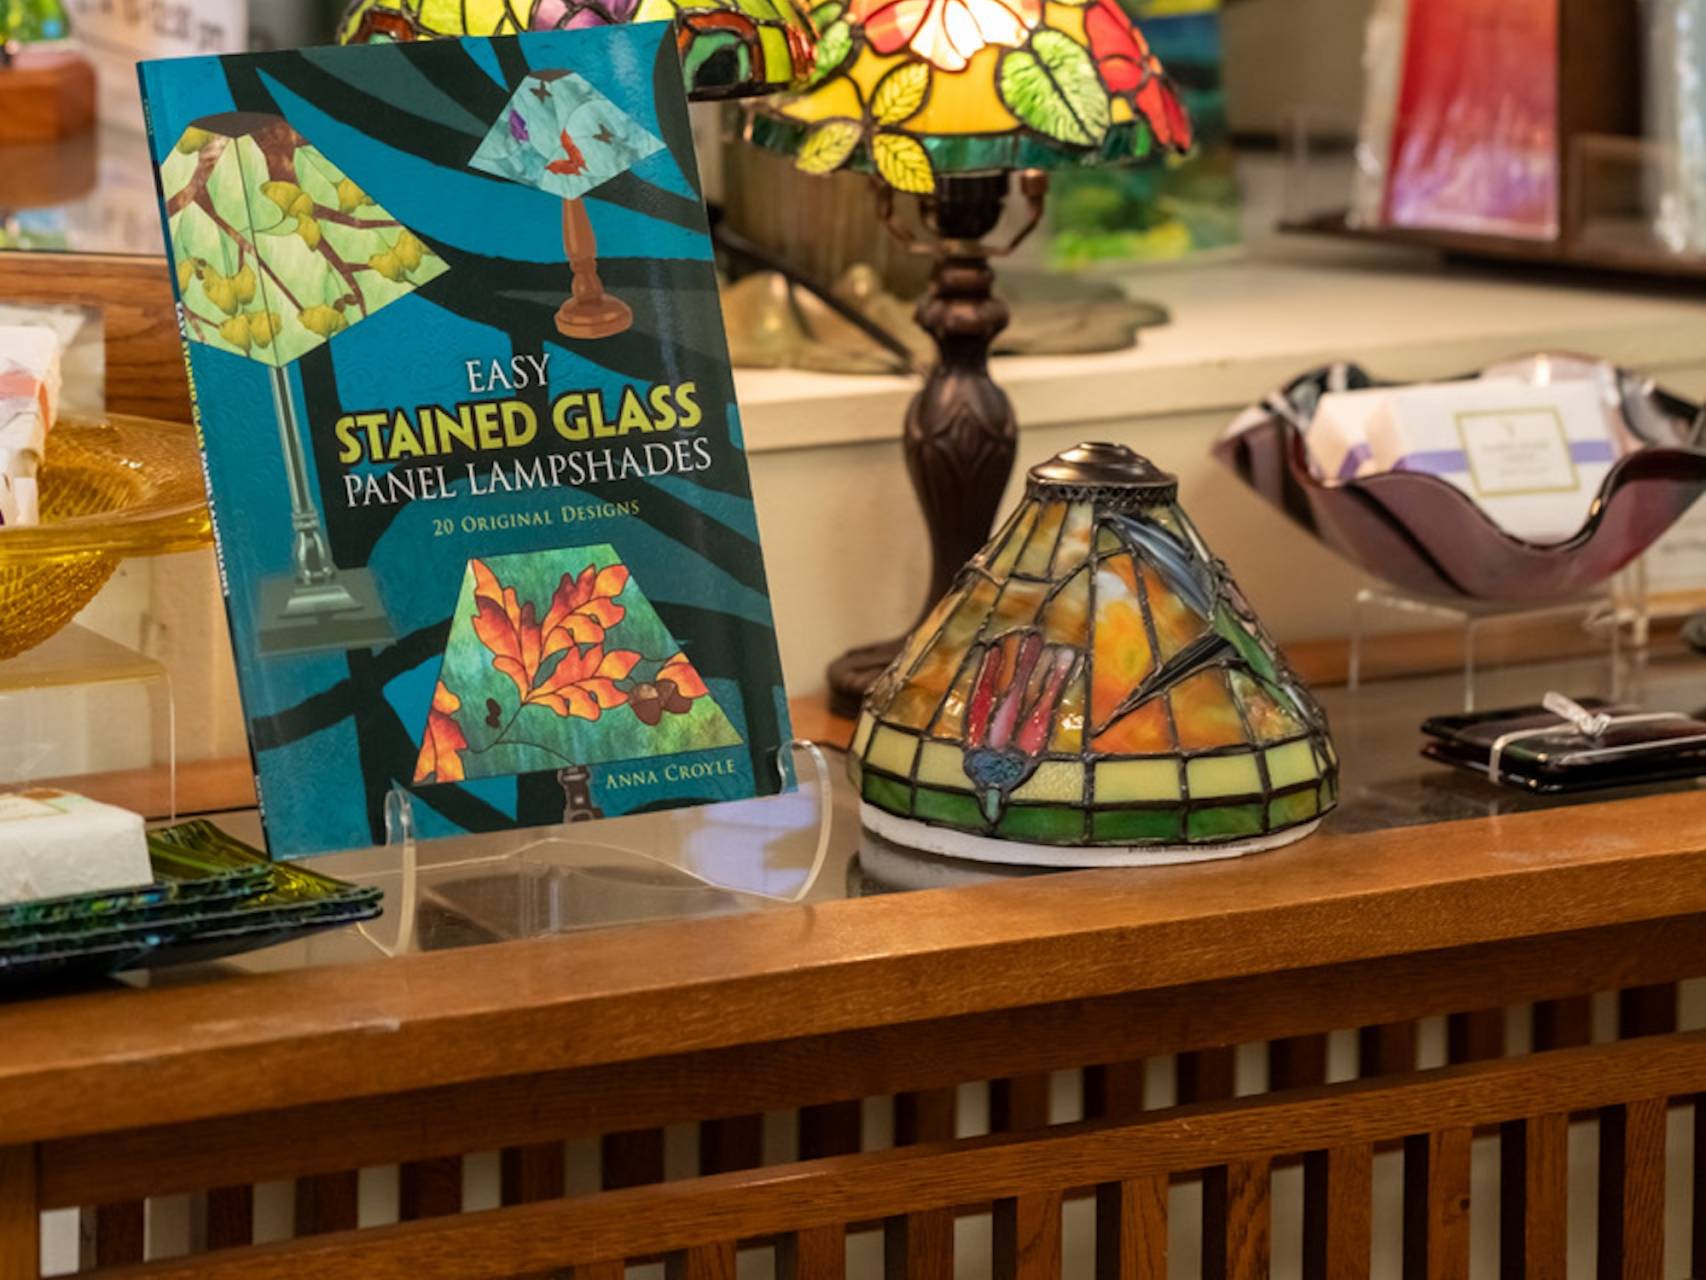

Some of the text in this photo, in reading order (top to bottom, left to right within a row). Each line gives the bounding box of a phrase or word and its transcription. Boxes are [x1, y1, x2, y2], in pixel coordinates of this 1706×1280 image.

[465, 353, 550, 393] EASY
[335, 381, 702, 464] STAINED GLASS
[343, 436, 712, 508] PANEL LAMPSHADES
[432, 500, 640, 536] 20 ORIGINAL DESIGNS
[605, 759, 736, 789] ANNA CROYLE
